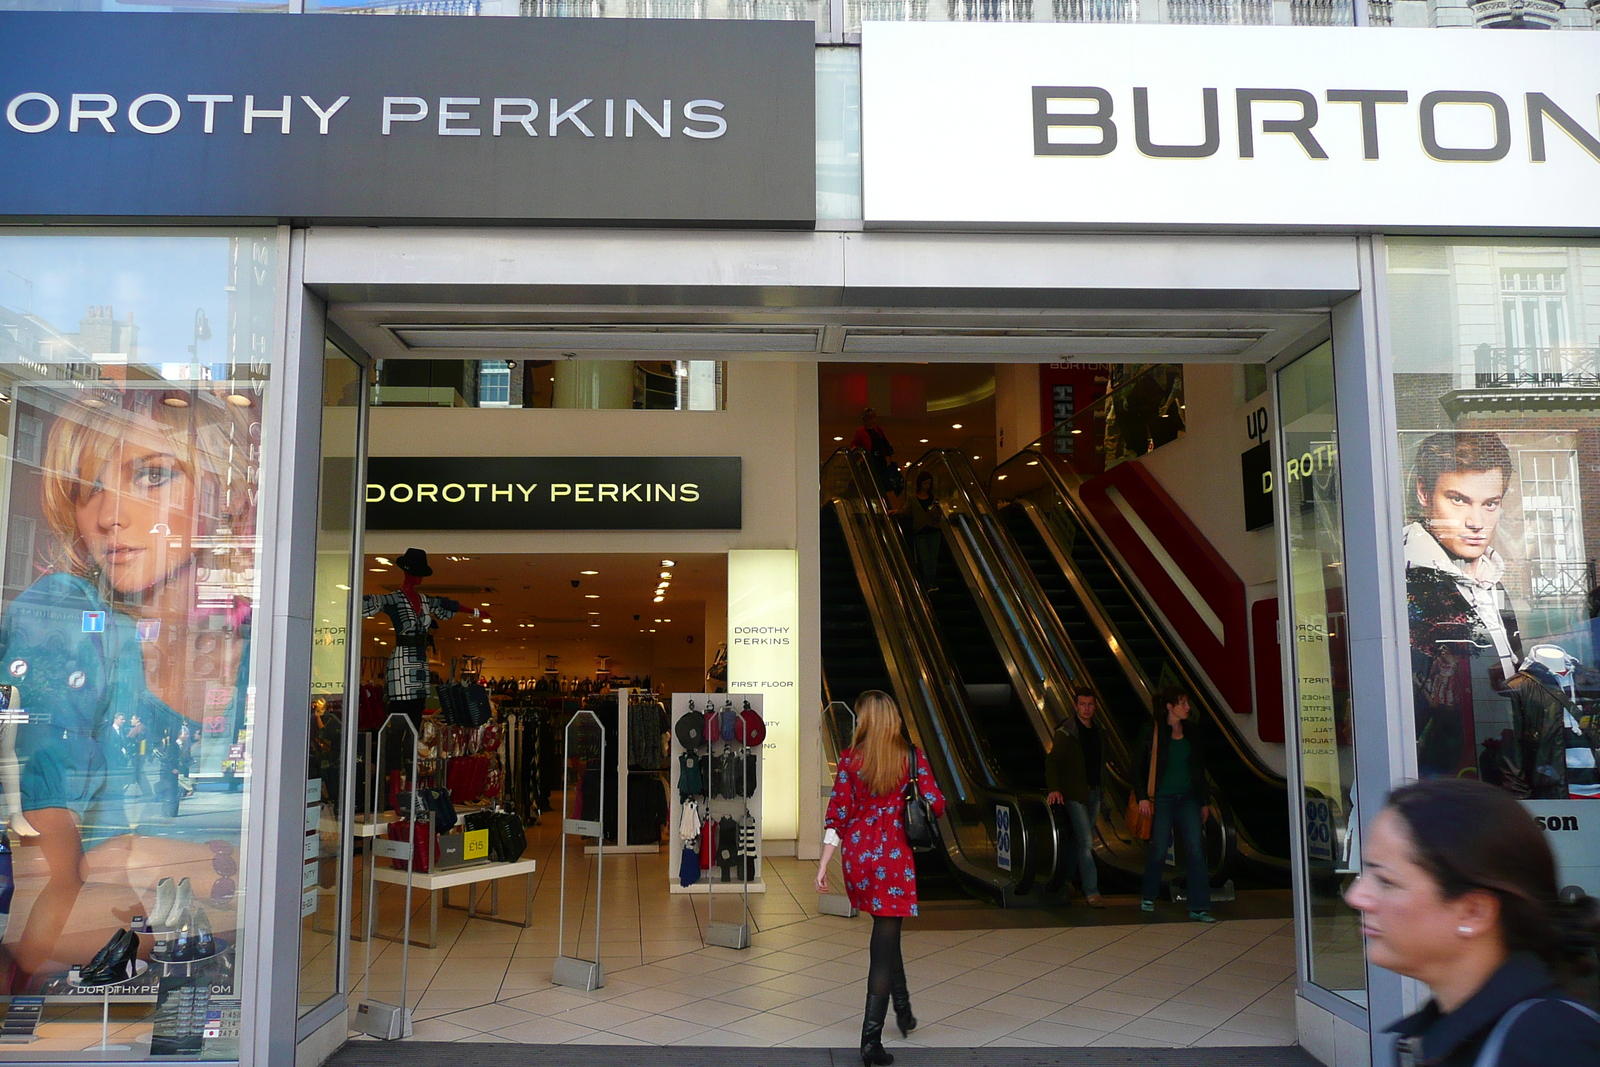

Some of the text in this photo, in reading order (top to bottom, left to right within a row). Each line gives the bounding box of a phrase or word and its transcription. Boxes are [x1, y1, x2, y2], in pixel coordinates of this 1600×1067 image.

[6, 92, 728, 139] OROTHY PERKINS
[1031, 85, 1600, 163] BURTON
[1247, 406, 1268, 444] up
[366, 483, 700, 502] DOROTHY PERKINS
[734, 626, 790, 634] DOROTHY
[734, 637, 790, 645] PERKINS
[469, 841, 483, 852] £15
